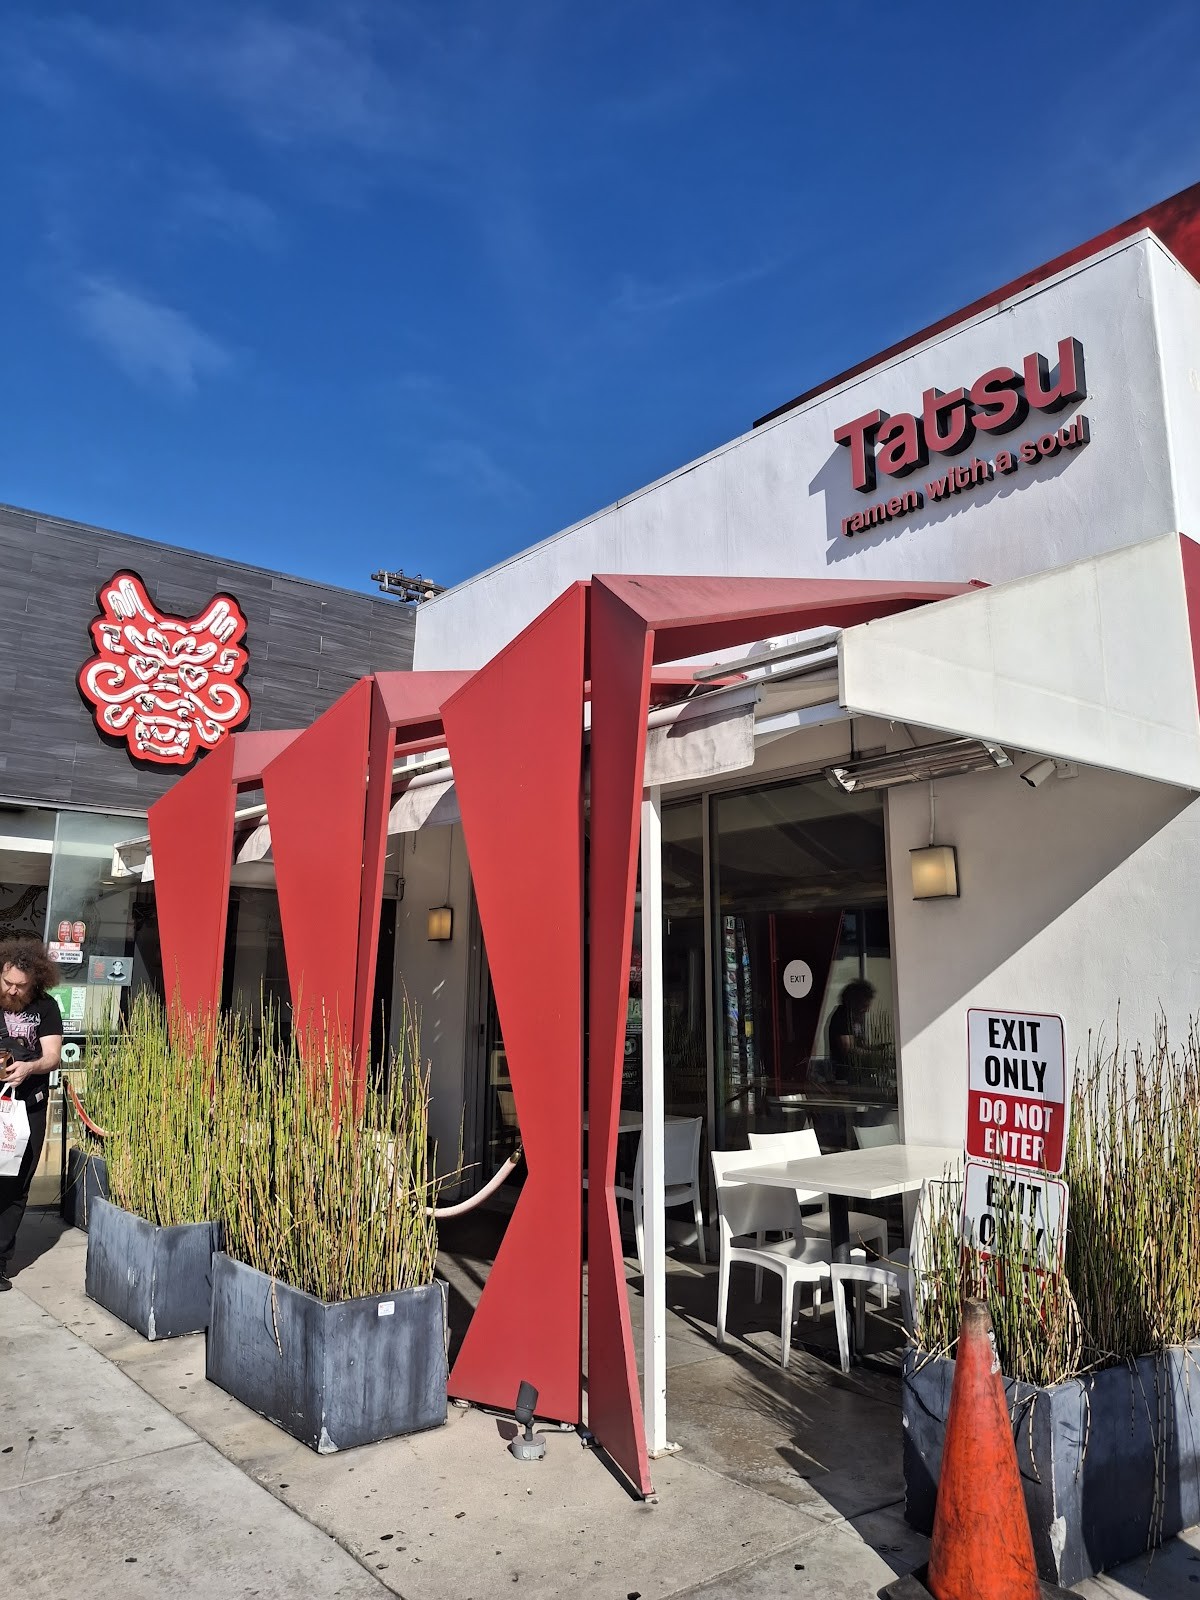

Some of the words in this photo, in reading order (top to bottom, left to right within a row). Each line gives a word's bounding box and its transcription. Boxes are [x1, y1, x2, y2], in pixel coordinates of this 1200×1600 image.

[834, 336, 1087, 493] Tatsu
[841, 489, 924, 537] ramen
[925, 457, 994, 502] with
[995, 450, 1018, 475] a
[1018, 414, 1091, 465] soul
[790, 974, 806, 983] EXIT
[988, 1017, 1041, 1053] EXIT
[985, 1055, 1047, 1093] ONLY
[980, 1097, 1007, 1125] DO
[1014, 1102, 1053, 1133] NOT
[984, 1127, 1044, 1163] ENTER
